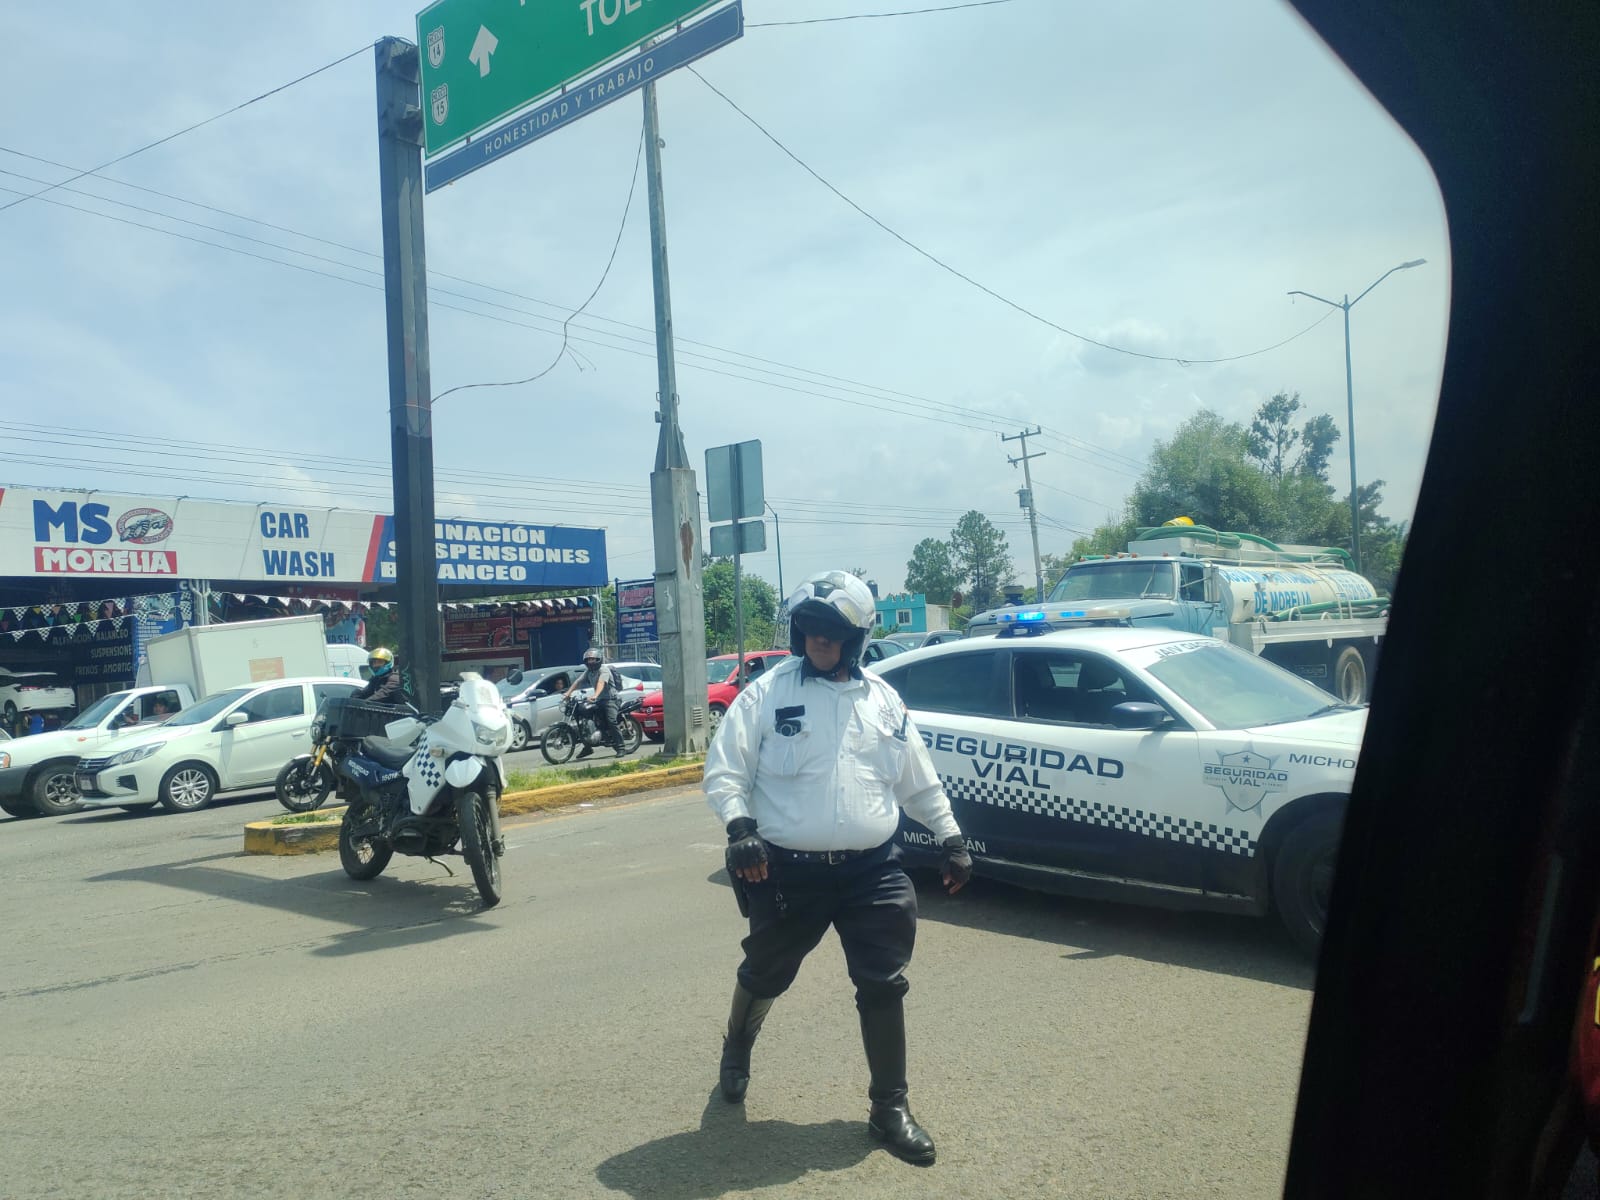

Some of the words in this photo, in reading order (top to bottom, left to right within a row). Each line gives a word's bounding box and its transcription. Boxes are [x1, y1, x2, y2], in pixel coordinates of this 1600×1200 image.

[433, 43, 441, 59] 14
[436, 100, 445, 116] 15
[484, 101, 569, 155] HONESTIDAD
[574, 94, 583, 109] Y
[588, 58, 655, 101] TRABAJO
[33, 499, 113, 545] MS
[260, 511, 310, 539] CAR
[42, 549, 172, 573] MORELIA
[263, 550, 336, 577] WASH
[381, 561, 527, 581] BANCEO
[1254, 591, 1268, 614] DE
[919, 731, 1125, 779] SEGURIDAD
[971, 759, 1051, 790] VIAL
[1204, 765, 1288, 781] SEGURIDAD
[1228, 776, 1261, 787] VIAL
